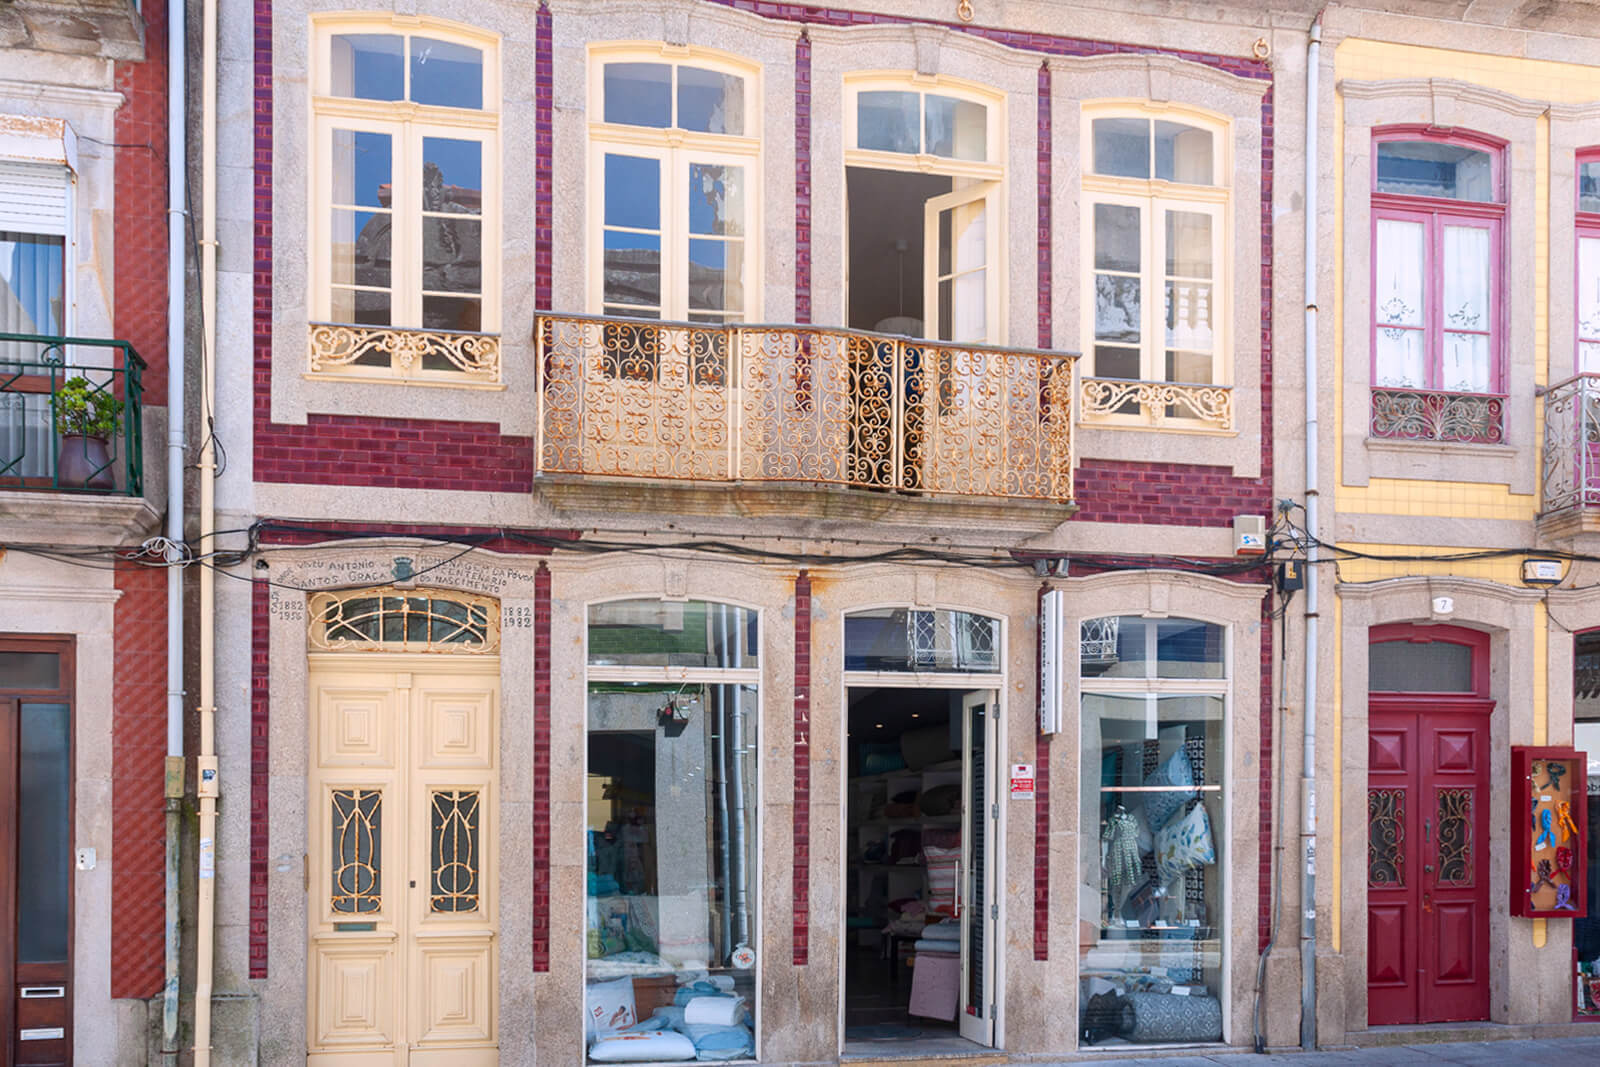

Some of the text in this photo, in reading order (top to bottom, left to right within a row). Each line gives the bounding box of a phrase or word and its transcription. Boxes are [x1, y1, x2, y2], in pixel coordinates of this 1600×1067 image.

[436, 575, 499, 592] NASCIMENTO
[279, 601, 304, 610] 1882
[1440, 599, 1448, 610] 7
[279, 611, 303, 621] 1956
[504, 607, 532, 616] 1882
[504, 617, 532, 628] 1982
